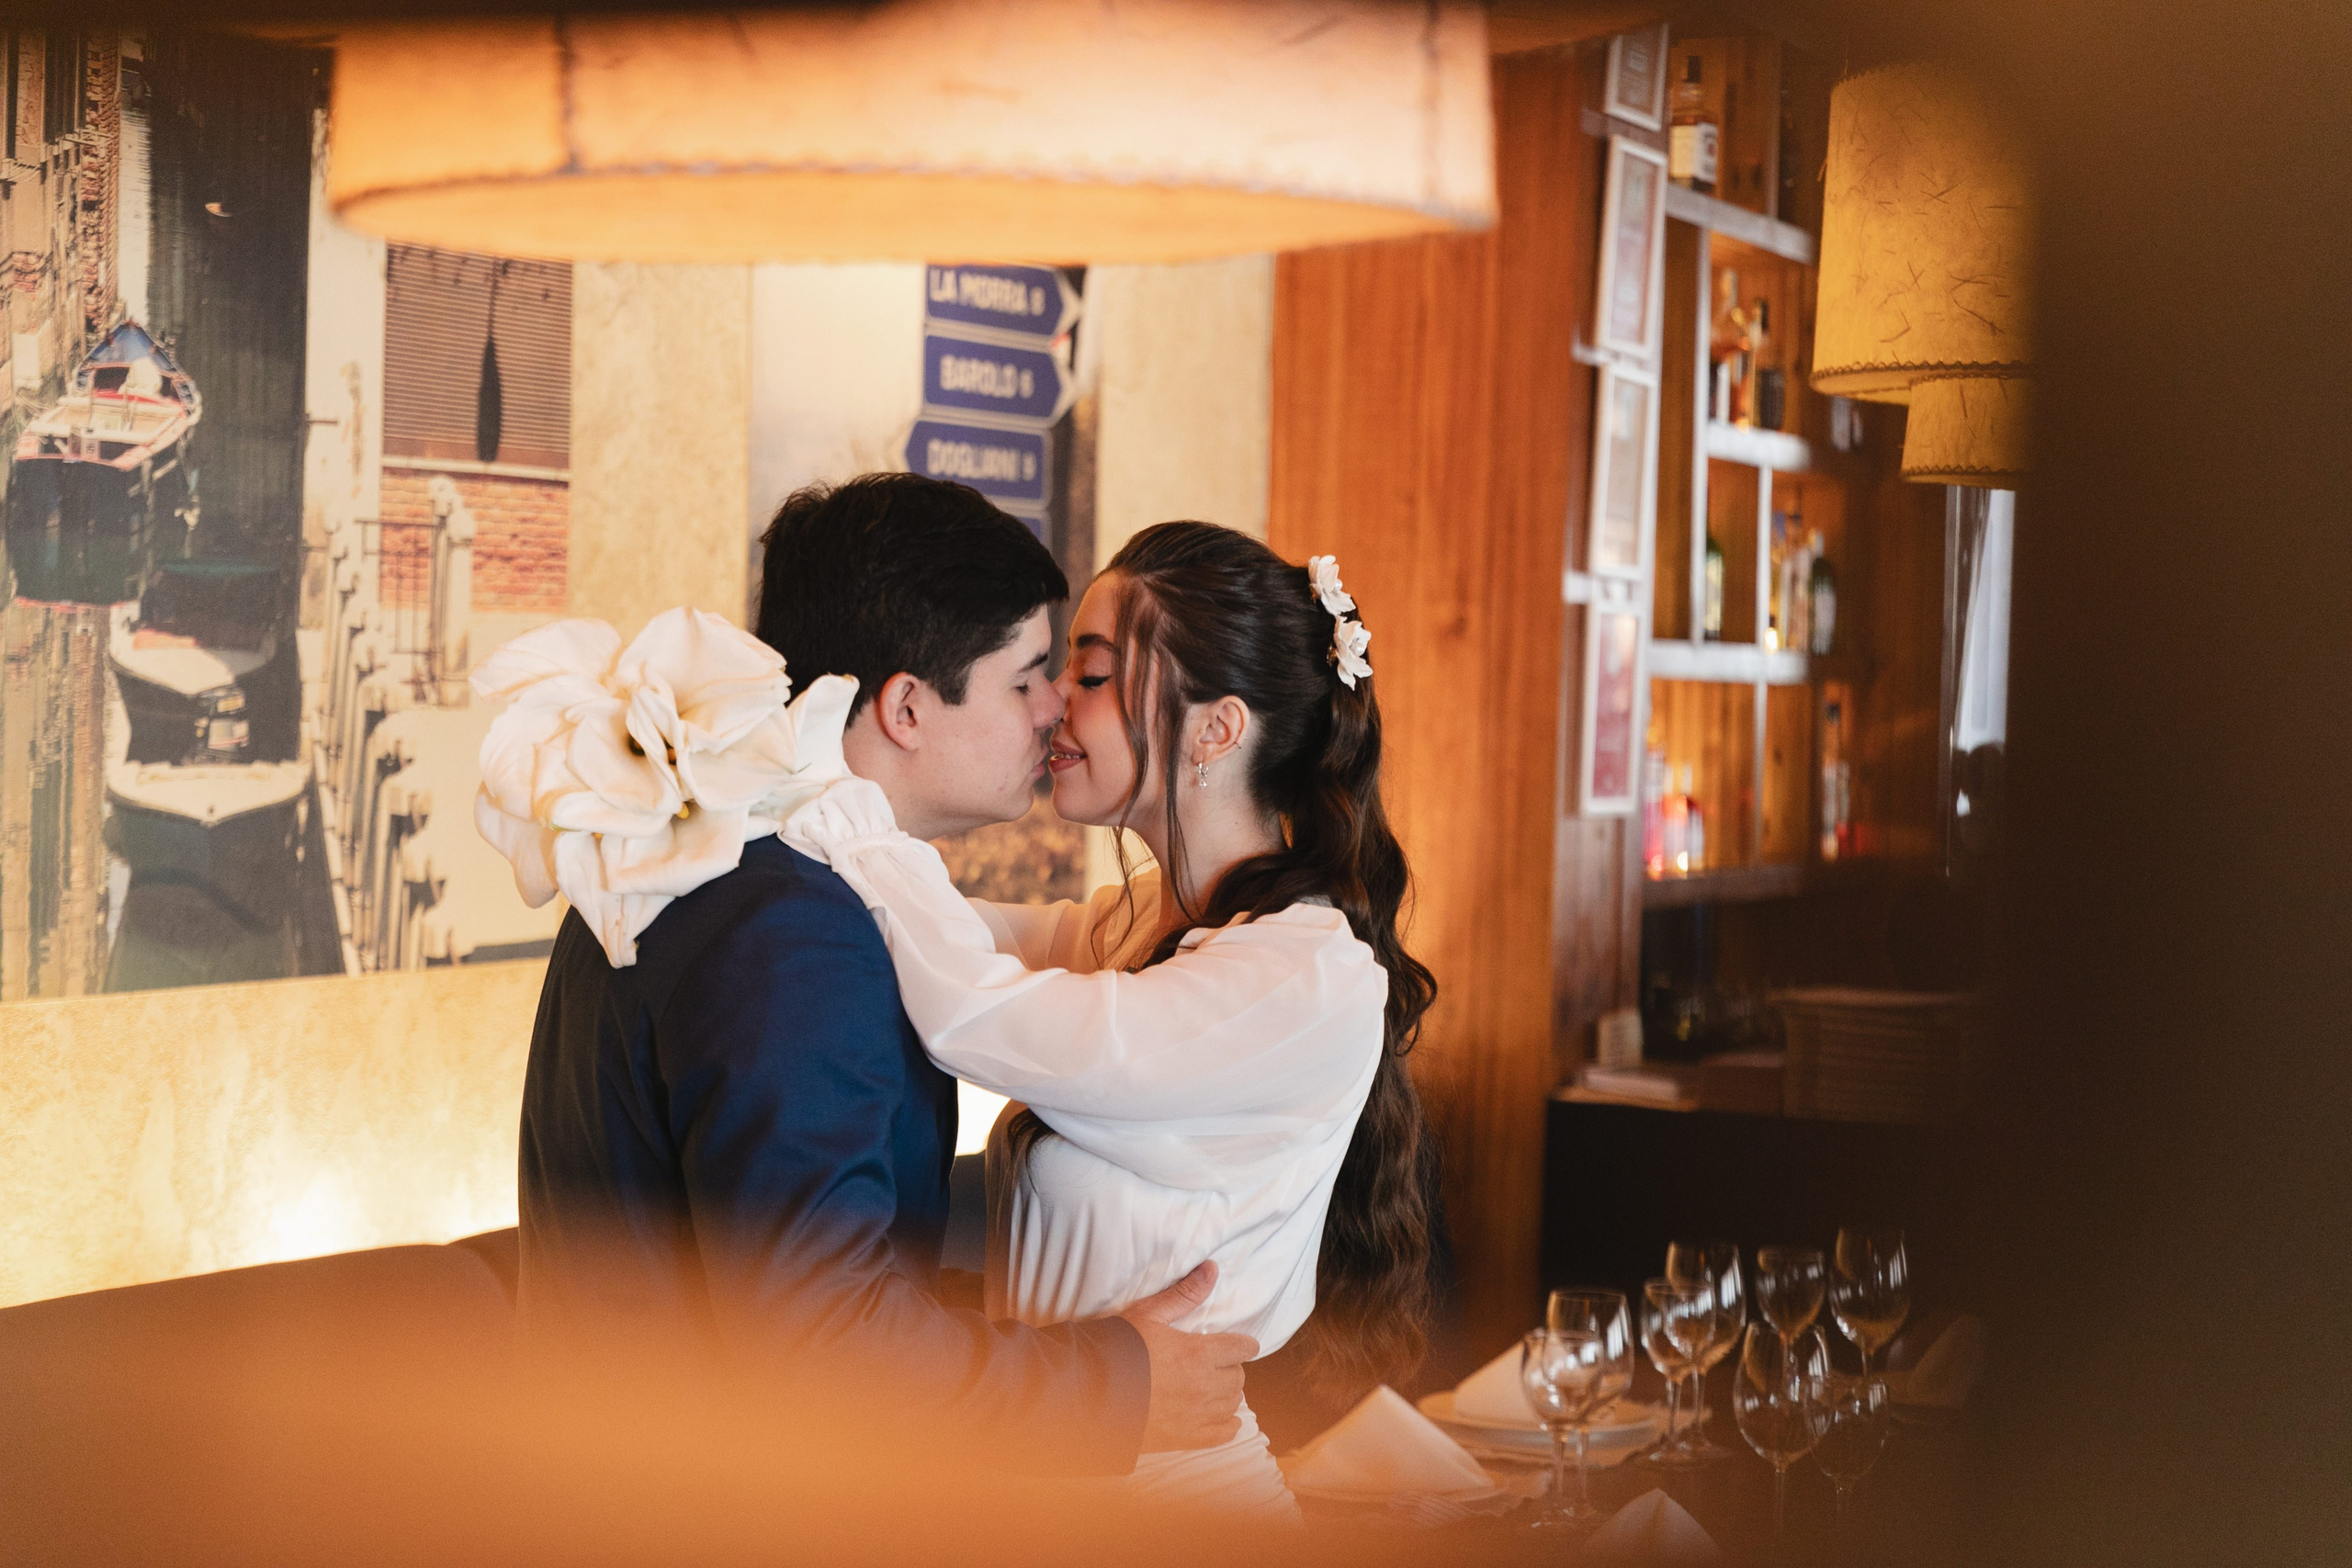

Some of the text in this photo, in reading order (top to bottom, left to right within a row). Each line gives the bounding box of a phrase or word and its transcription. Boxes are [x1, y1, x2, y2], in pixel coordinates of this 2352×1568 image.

[929, 267, 957, 303] LA
[959, 272, 1027, 316] MORRA
[939, 354, 1019, 400] BAROLO
[926, 438, 1019, 481] DOGLIANI
